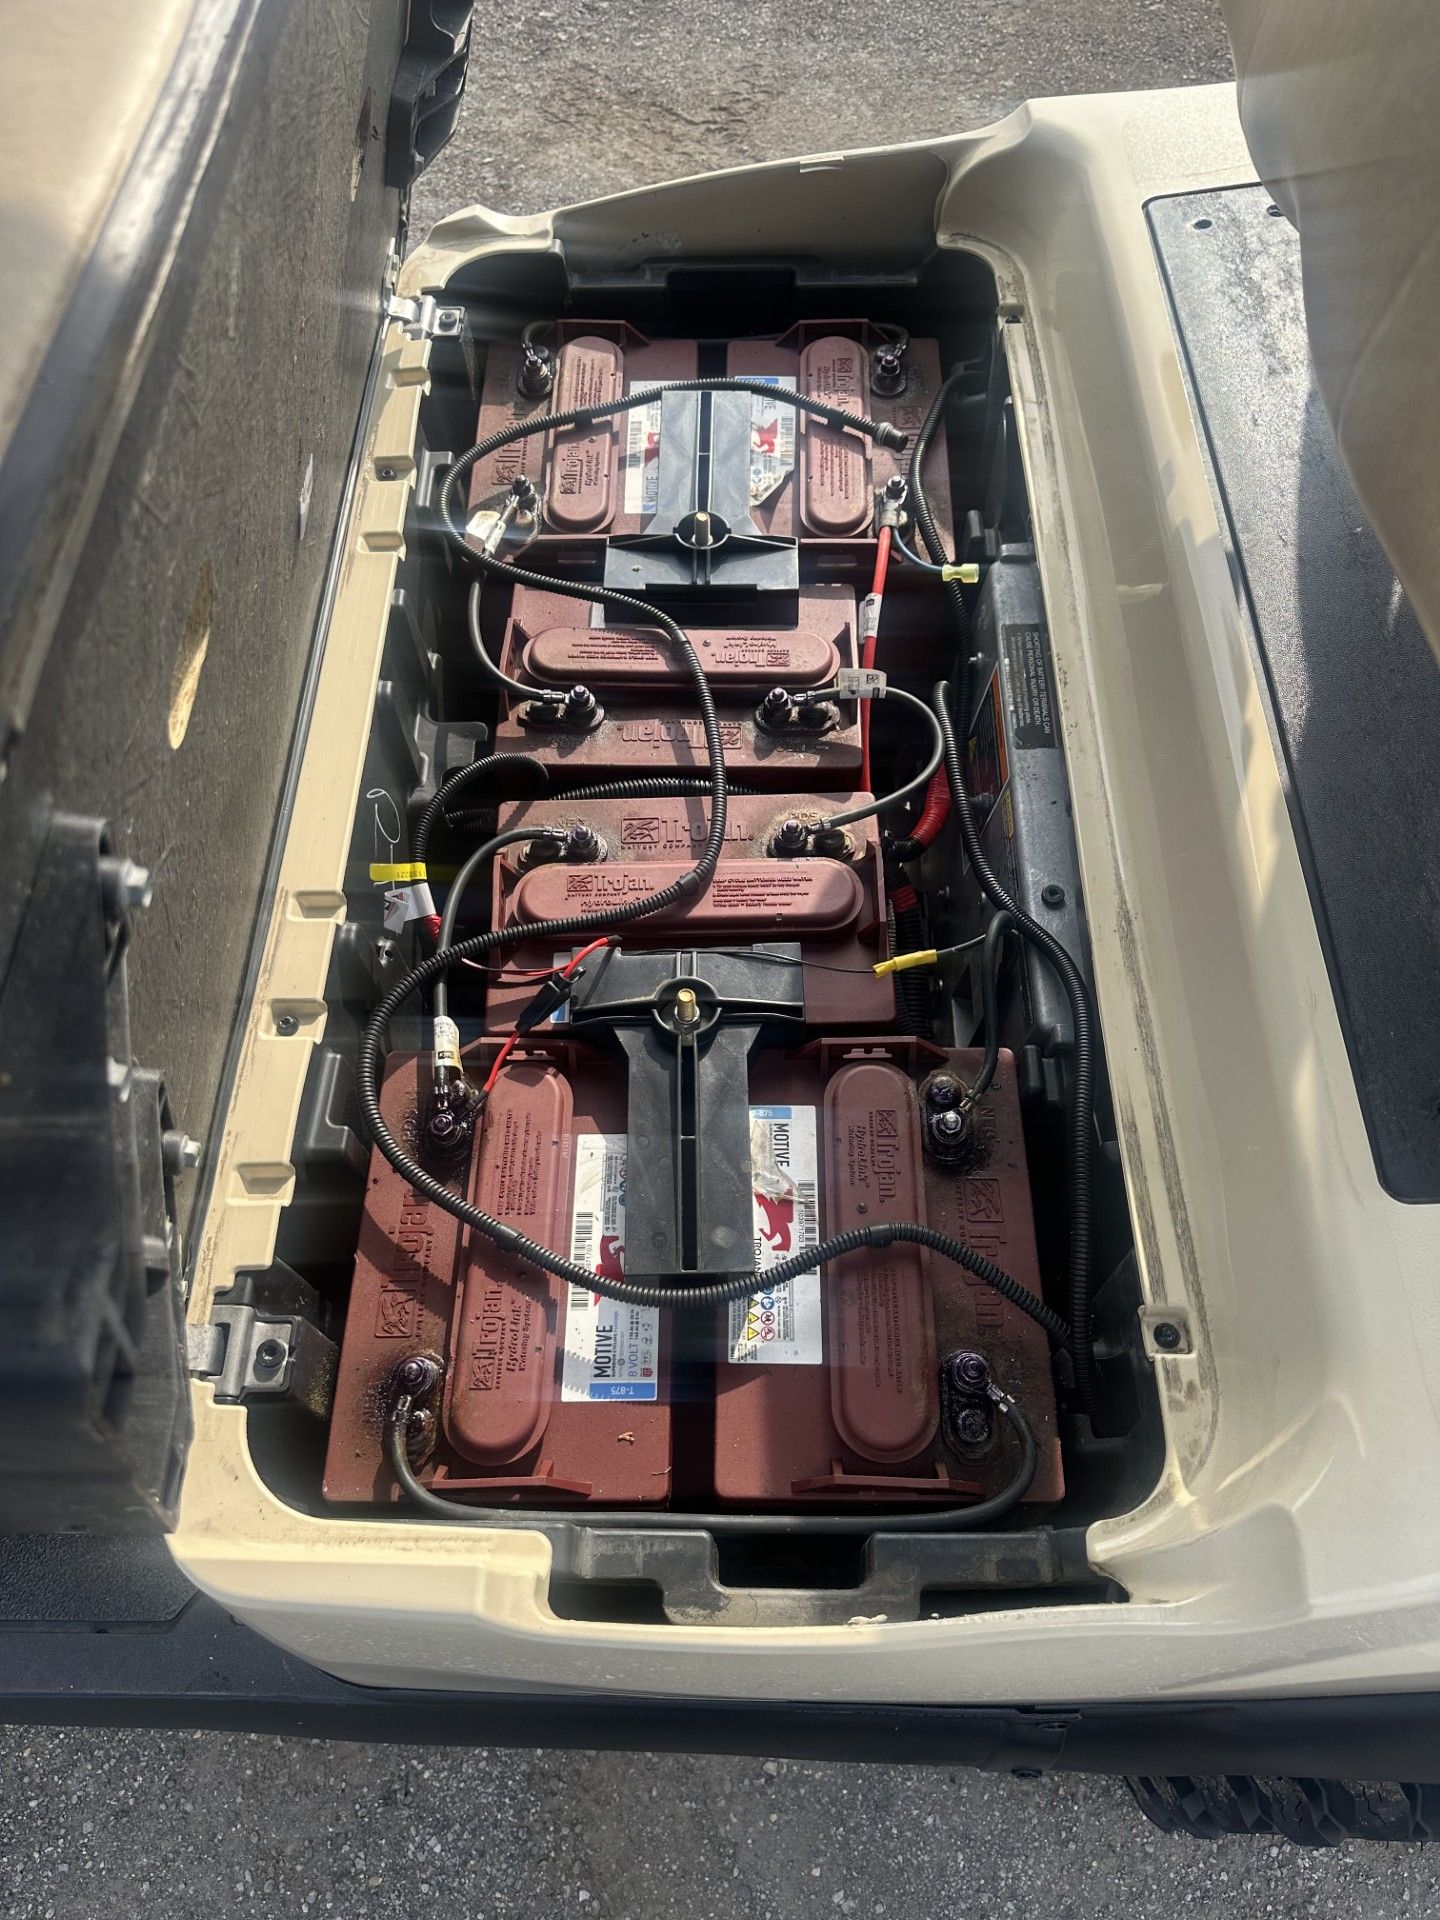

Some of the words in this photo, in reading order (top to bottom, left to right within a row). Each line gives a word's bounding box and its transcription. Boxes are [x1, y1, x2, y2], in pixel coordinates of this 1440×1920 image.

[715, 649, 765, 667] Trojan
[1027, 650, 1036, 677] PERSONAL
[1033, 707, 1041, 725] DEATH
[1042, 722, 1050, 734] CAN
[594, 875, 650, 895] Trojan
[774, 1123, 789, 1167] MOTIVE
[873, 1141, 901, 1197] Trojan
[472, 1288, 506, 1356] Trojan
[594, 1325, 613, 1378] MOTIVE
[629, 1343, 638, 1368] VOLT
[611, 1386, 635, 1395] T-875
